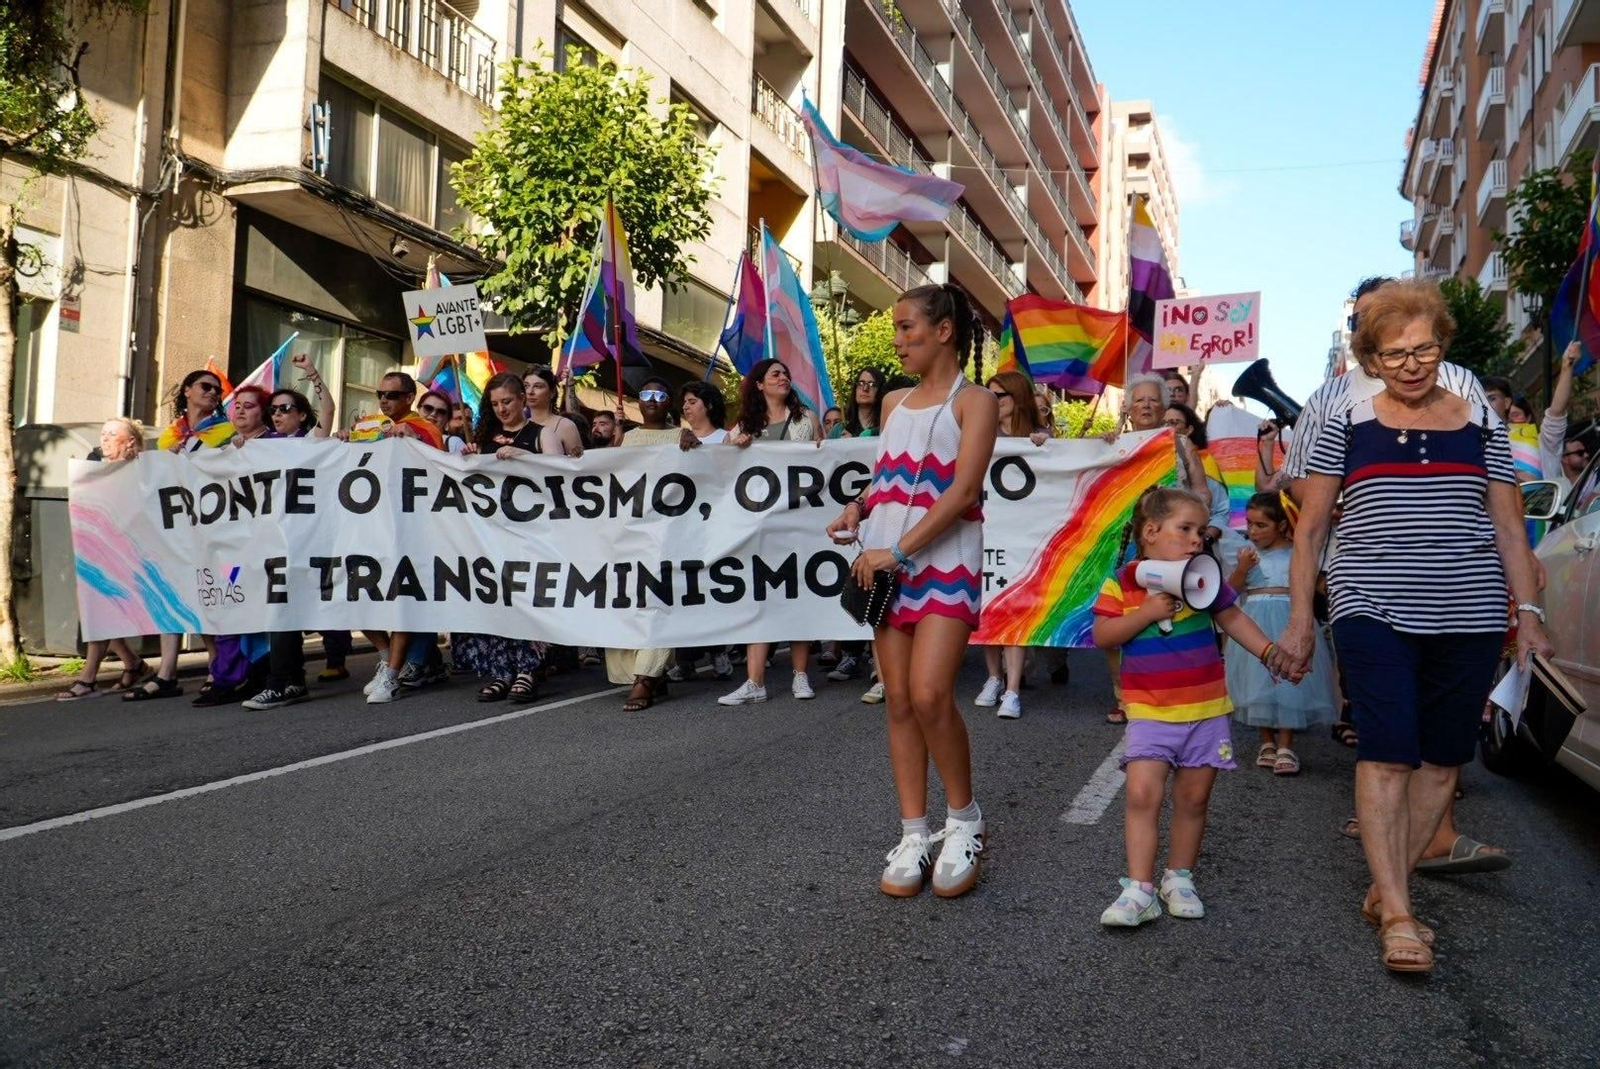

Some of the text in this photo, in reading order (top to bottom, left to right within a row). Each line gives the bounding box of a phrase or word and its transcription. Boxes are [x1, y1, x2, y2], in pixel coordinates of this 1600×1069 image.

[436, 298, 477, 315] AVANTE
[437, 314, 480, 336] LGBT+
[338, 452, 381, 514] Ó
[402, 468, 712, 522] FASCISMO,
[264, 550, 848, 609] E TRANSFEMINISMO
